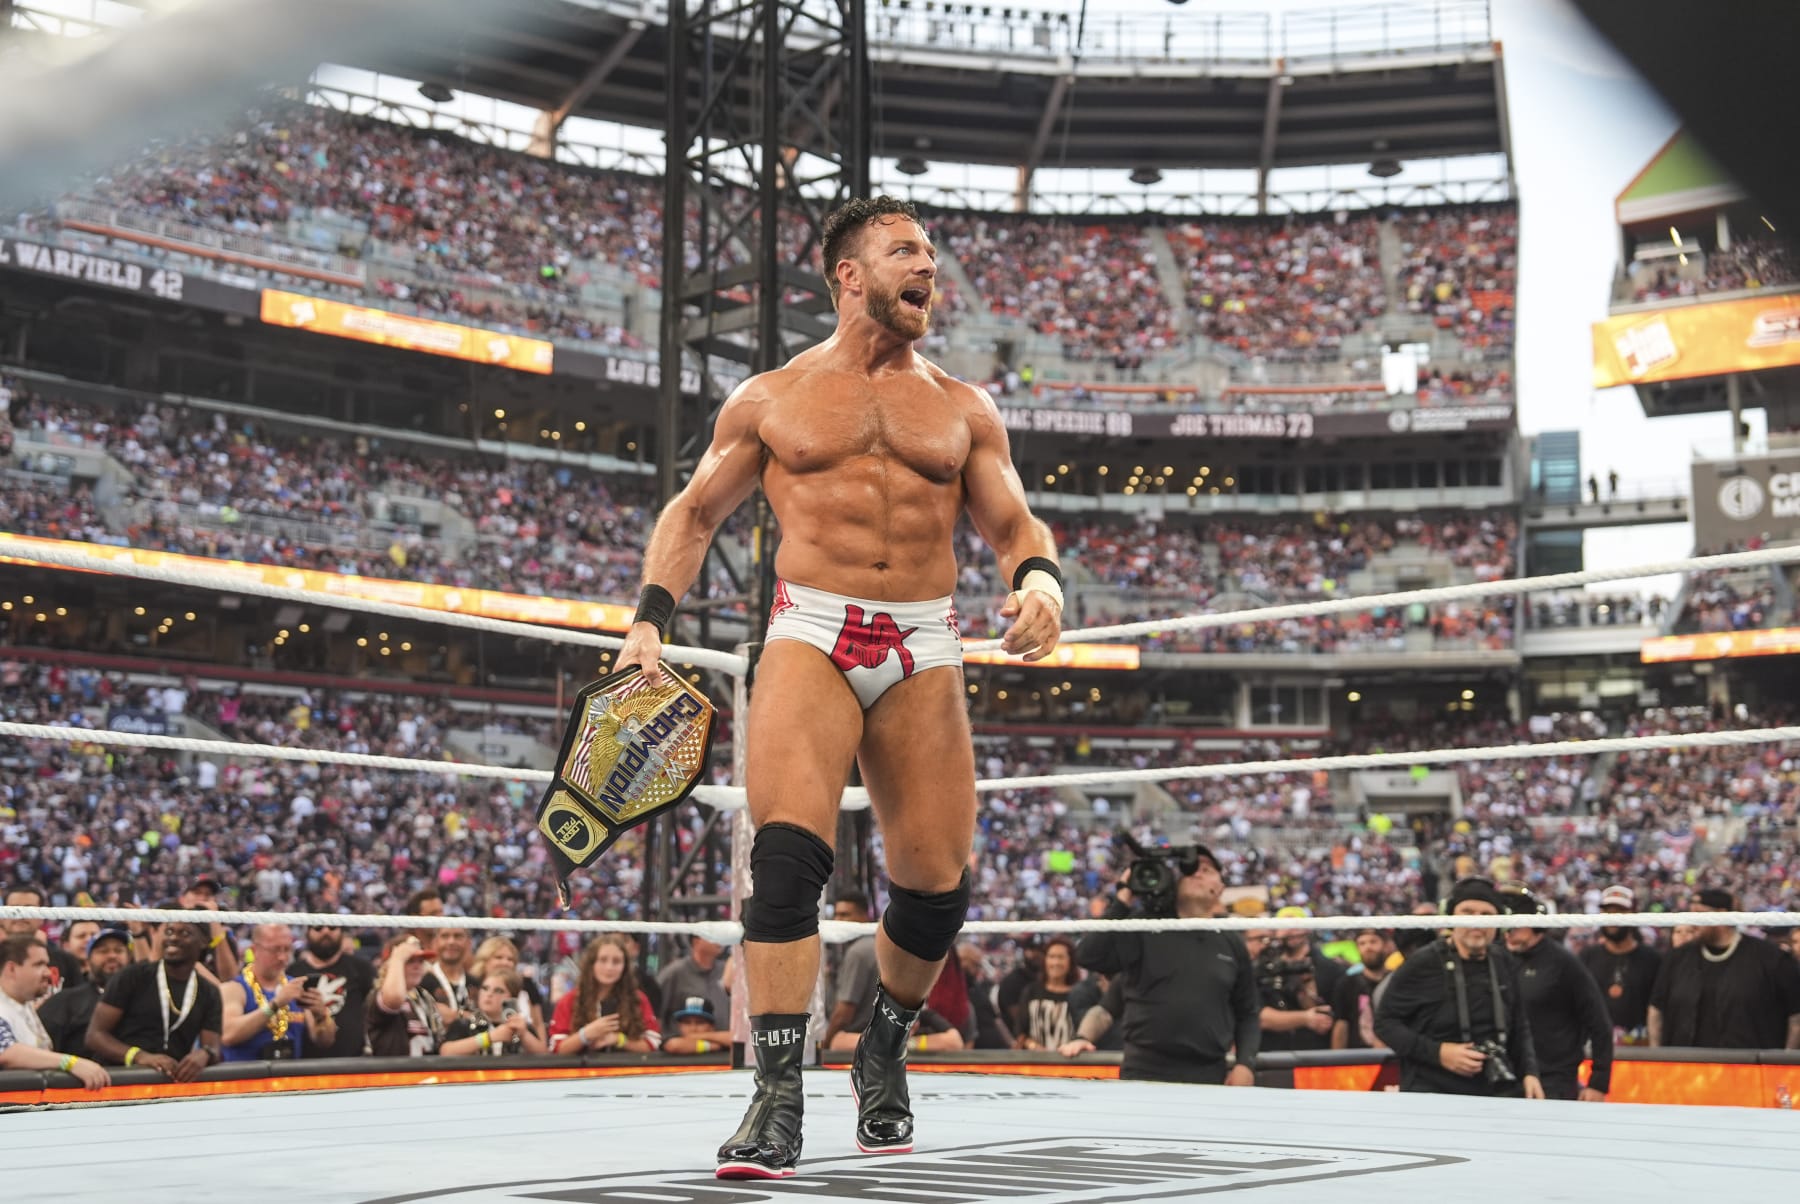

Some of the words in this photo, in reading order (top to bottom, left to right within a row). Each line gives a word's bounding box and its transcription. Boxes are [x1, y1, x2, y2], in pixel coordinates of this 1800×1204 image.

[14, 241, 142, 291] WARFIELD
[149, 268, 184, 300] 42
[1208, 413, 1286, 437] THOMAS
[600, 692, 704, 813] CHAMPION
[504, 1145, 1343, 1204] PRIME
